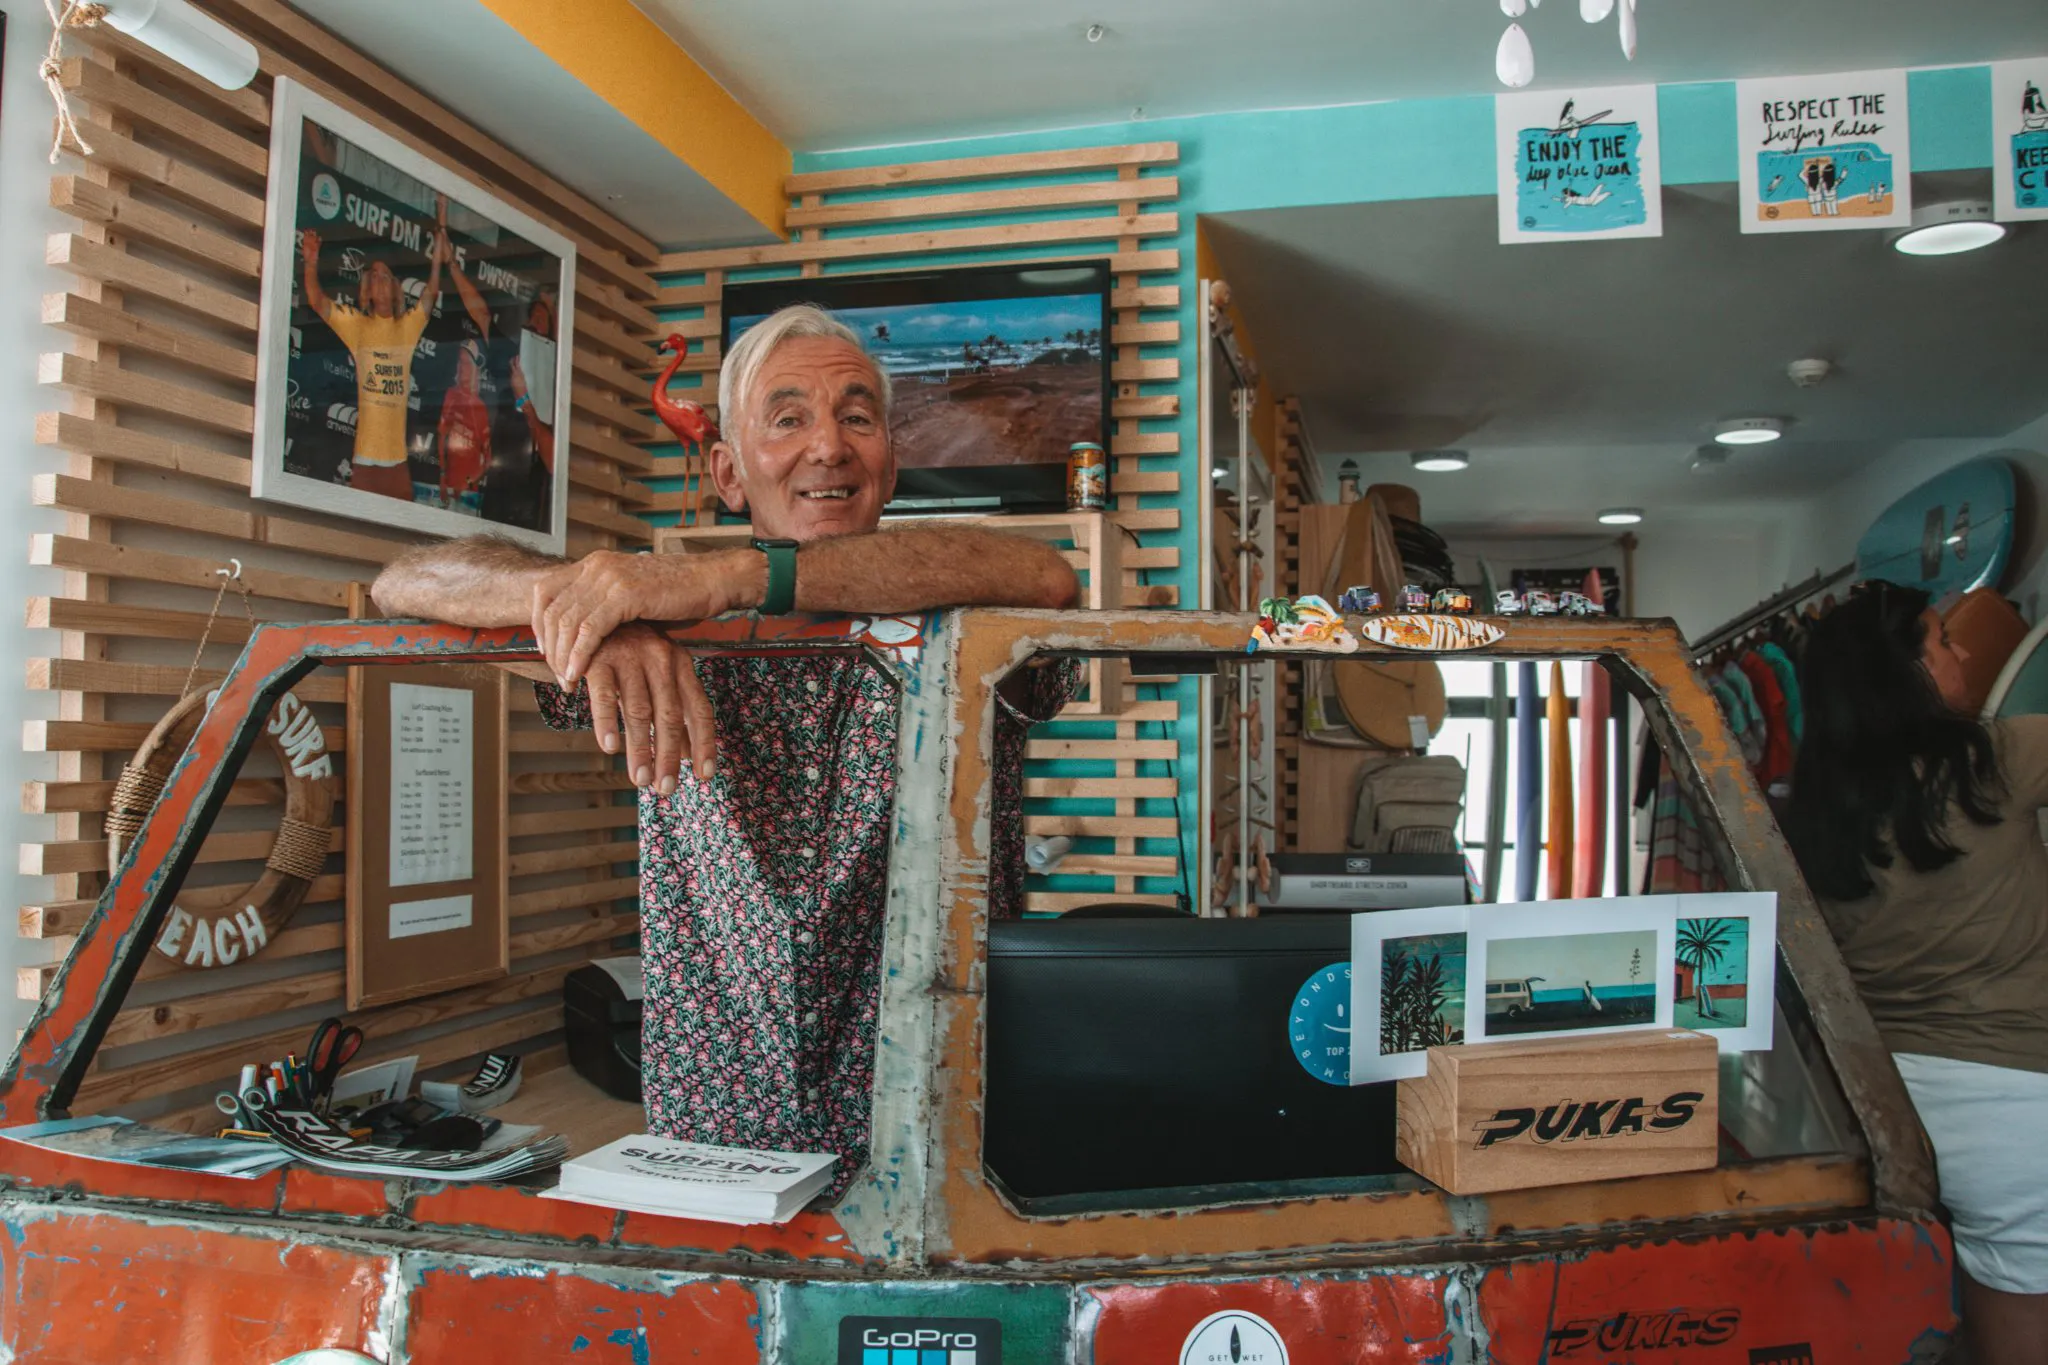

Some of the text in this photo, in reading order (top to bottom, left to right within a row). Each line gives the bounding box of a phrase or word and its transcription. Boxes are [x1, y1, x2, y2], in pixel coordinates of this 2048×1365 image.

[1762, 94, 1886, 123] RESPECT THE
[1527, 135, 1628, 162] ENJOY THE
[1762, 119, 1885, 153] Surfing Rules
[2016, 147, 2048, 169] KEE
[1526, 166, 1551, 191] deep
[1557, 164, 1589, 181] blue
[345, 193, 467, 273] SURF DM 25
[374, 363, 393, 377] SURF
[382, 379, 405, 396] 2015
[268, 692, 333, 781] SURF
[1355, 881, 1384, 889] STRETCH
[1386, 881, 1408, 889] COVER
[156, 904, 267, 968] EACH
[1295, 968, 1352, 1059] BEYONDS
[1326, 1047, 1345, 1057] TOP
[473, 1054, 506, 1088] NUI
[1473, 1091, 1705, 1150] PUKAS
[620, 1147, 802, 1175] SURFING
[863, 1328, 977, 1348] GoPro
[1549, 1308, 1741, 1357] PUKAS
[1208, 1354, 1229, 1362] GET
